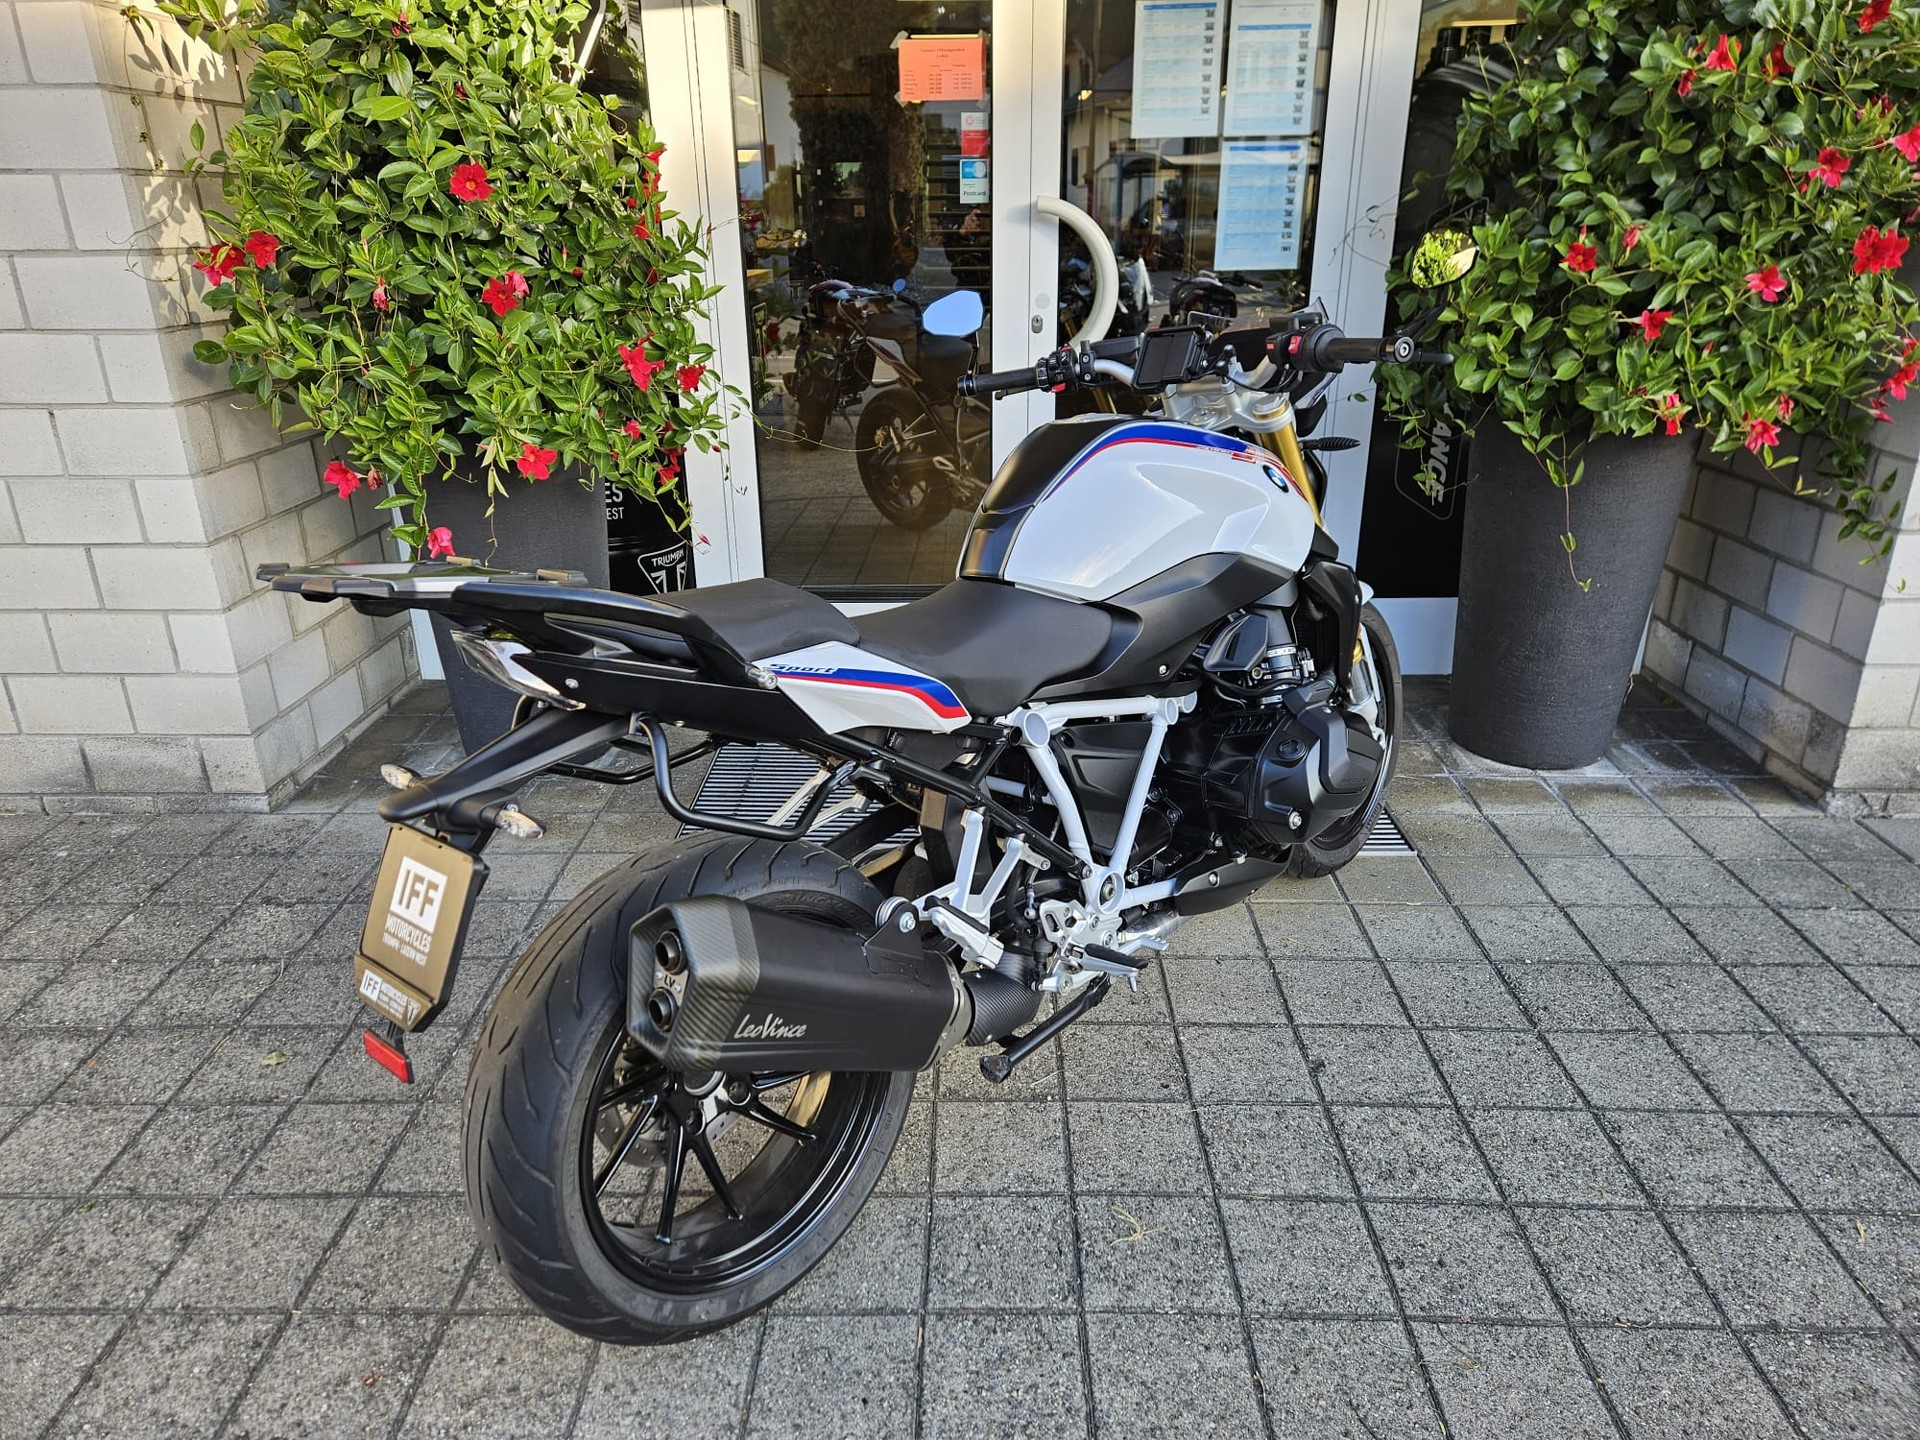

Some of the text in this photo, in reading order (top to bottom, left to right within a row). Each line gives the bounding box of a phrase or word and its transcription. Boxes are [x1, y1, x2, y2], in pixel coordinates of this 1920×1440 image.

[651, 549, 685, 567] TRIUMPH
[767, 663, 836, 673] Sport
[398, 868, 439, 918] IFF
[384, 913, 432, 954] MOTORCYCLES
[363, 974, 379, 995] IFF
[664, 974, 676, 988] LV
[733, 1012, 808, 1039] LeoVince
